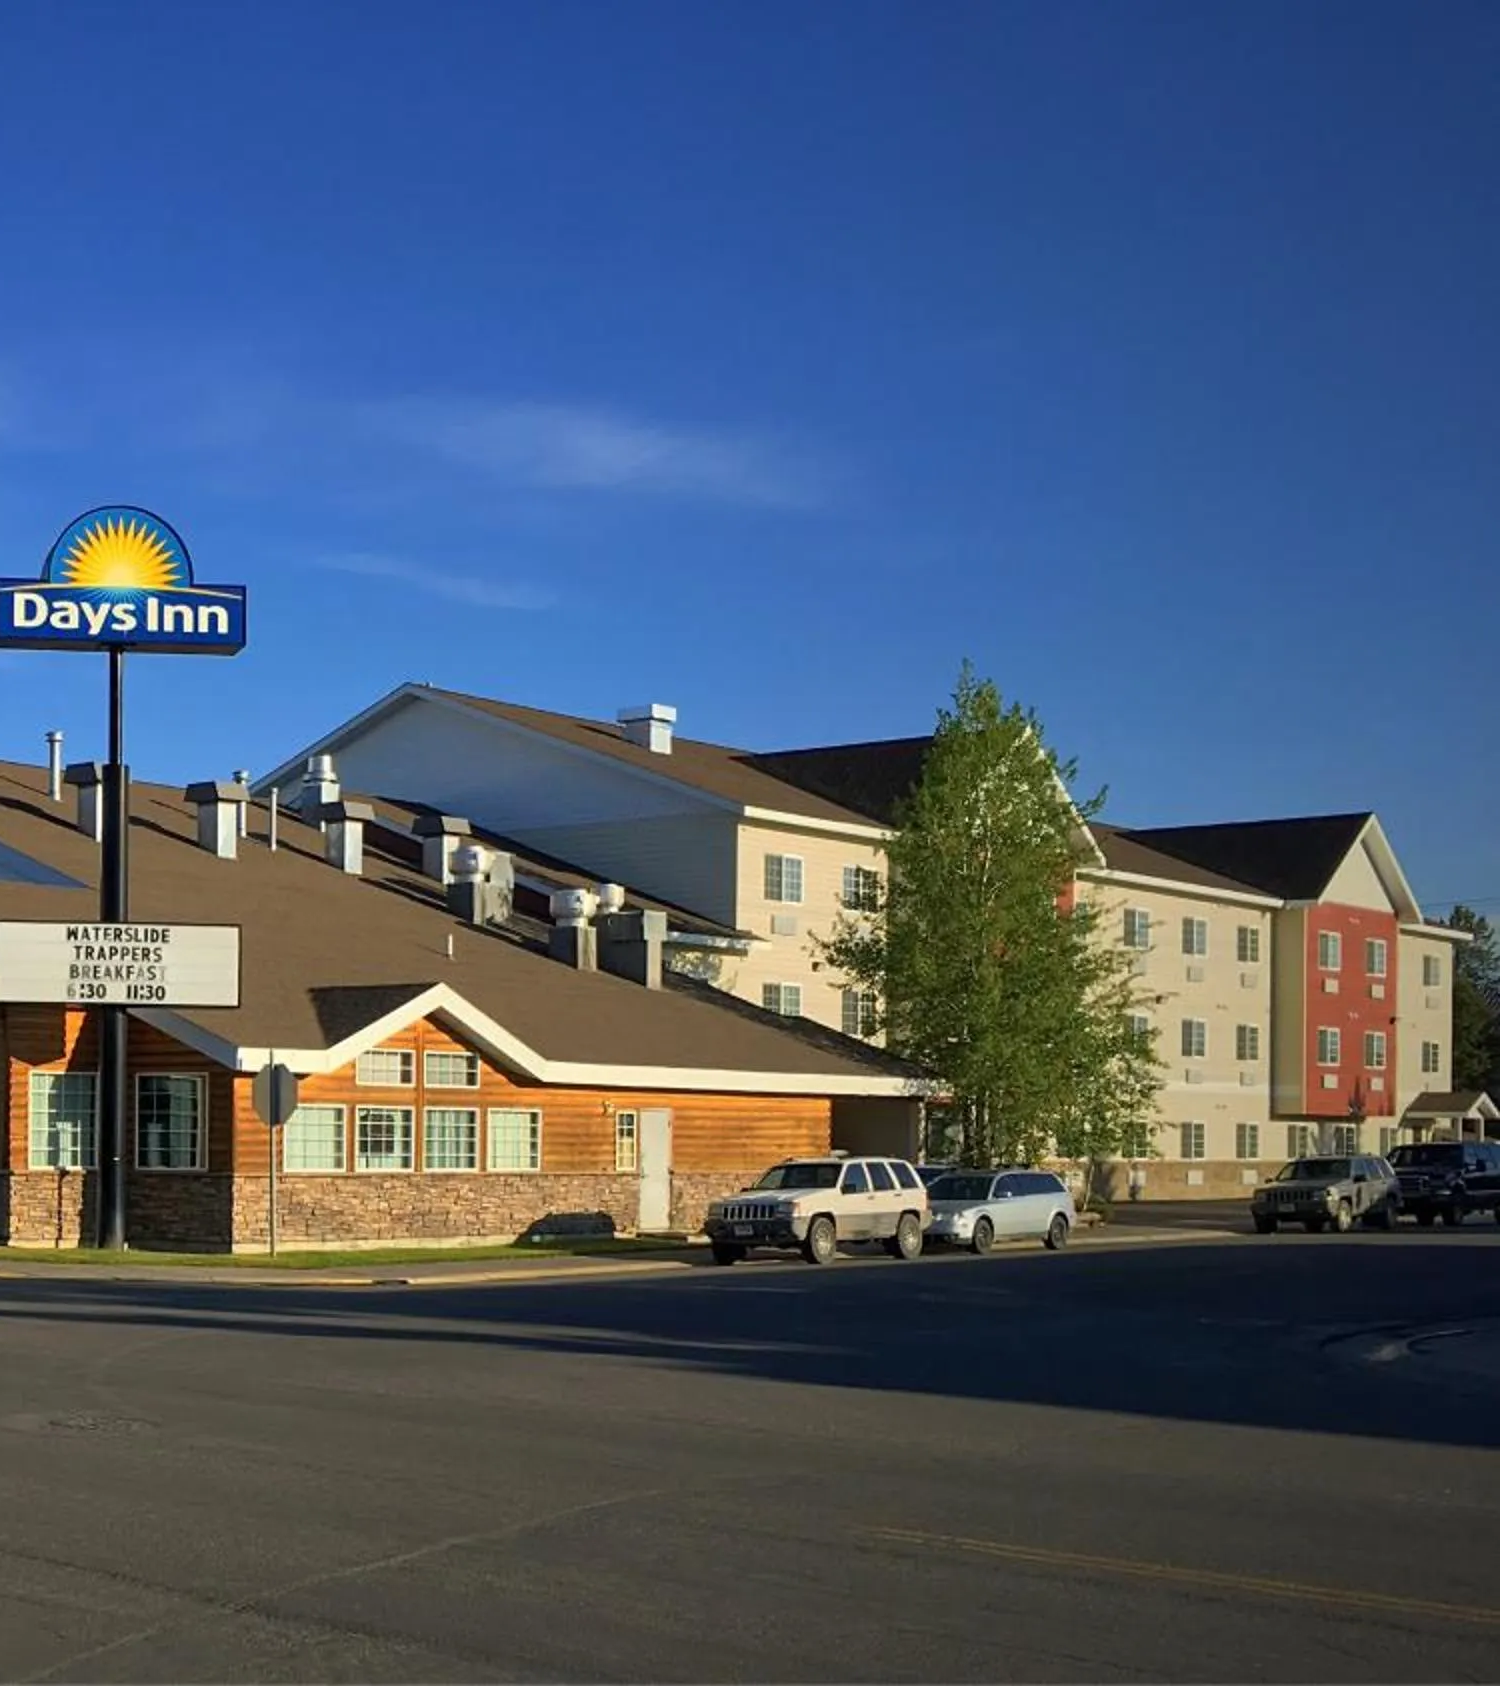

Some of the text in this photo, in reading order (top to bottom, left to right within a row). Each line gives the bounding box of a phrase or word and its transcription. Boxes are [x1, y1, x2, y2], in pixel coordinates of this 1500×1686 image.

[12, 591, 229, 635] Days Inn
[66, 926, 171, 943] WATERSLIDE
[74, 945, 163, 962] TRAPPERS
[69, 964, 167, 981] BREAKFAST
[67, 983, 166, 1000] 6:30 11:30
